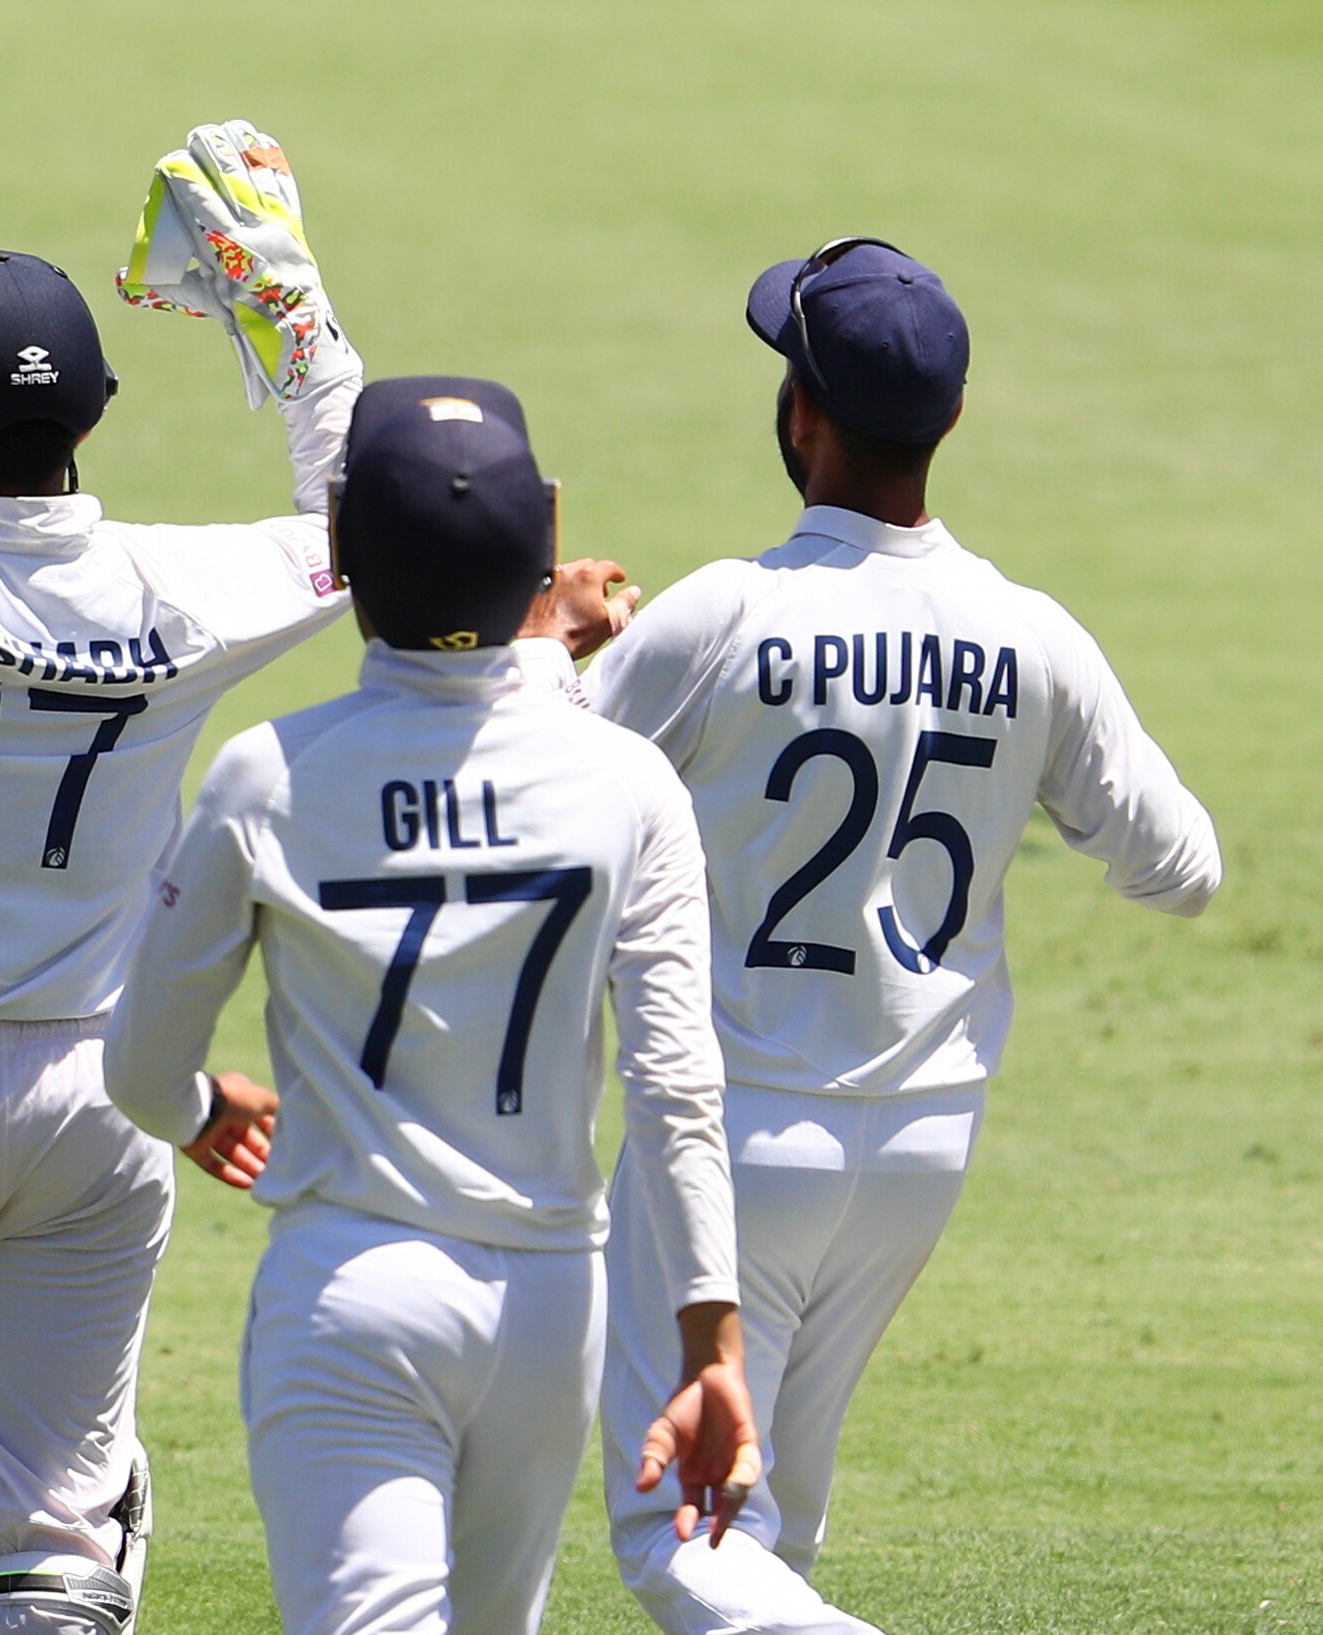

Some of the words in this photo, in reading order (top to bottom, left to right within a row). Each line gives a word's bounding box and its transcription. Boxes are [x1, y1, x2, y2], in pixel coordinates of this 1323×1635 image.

[10, 371, 59, 385] SHREY
[757, 637, 793, 706] C
[813, 631, 1018, 719] PUJARA
[380, 779, 519, 851] GILL
[744, 727, 998, 975] 25
[318, 867, 593, 1115] 77
